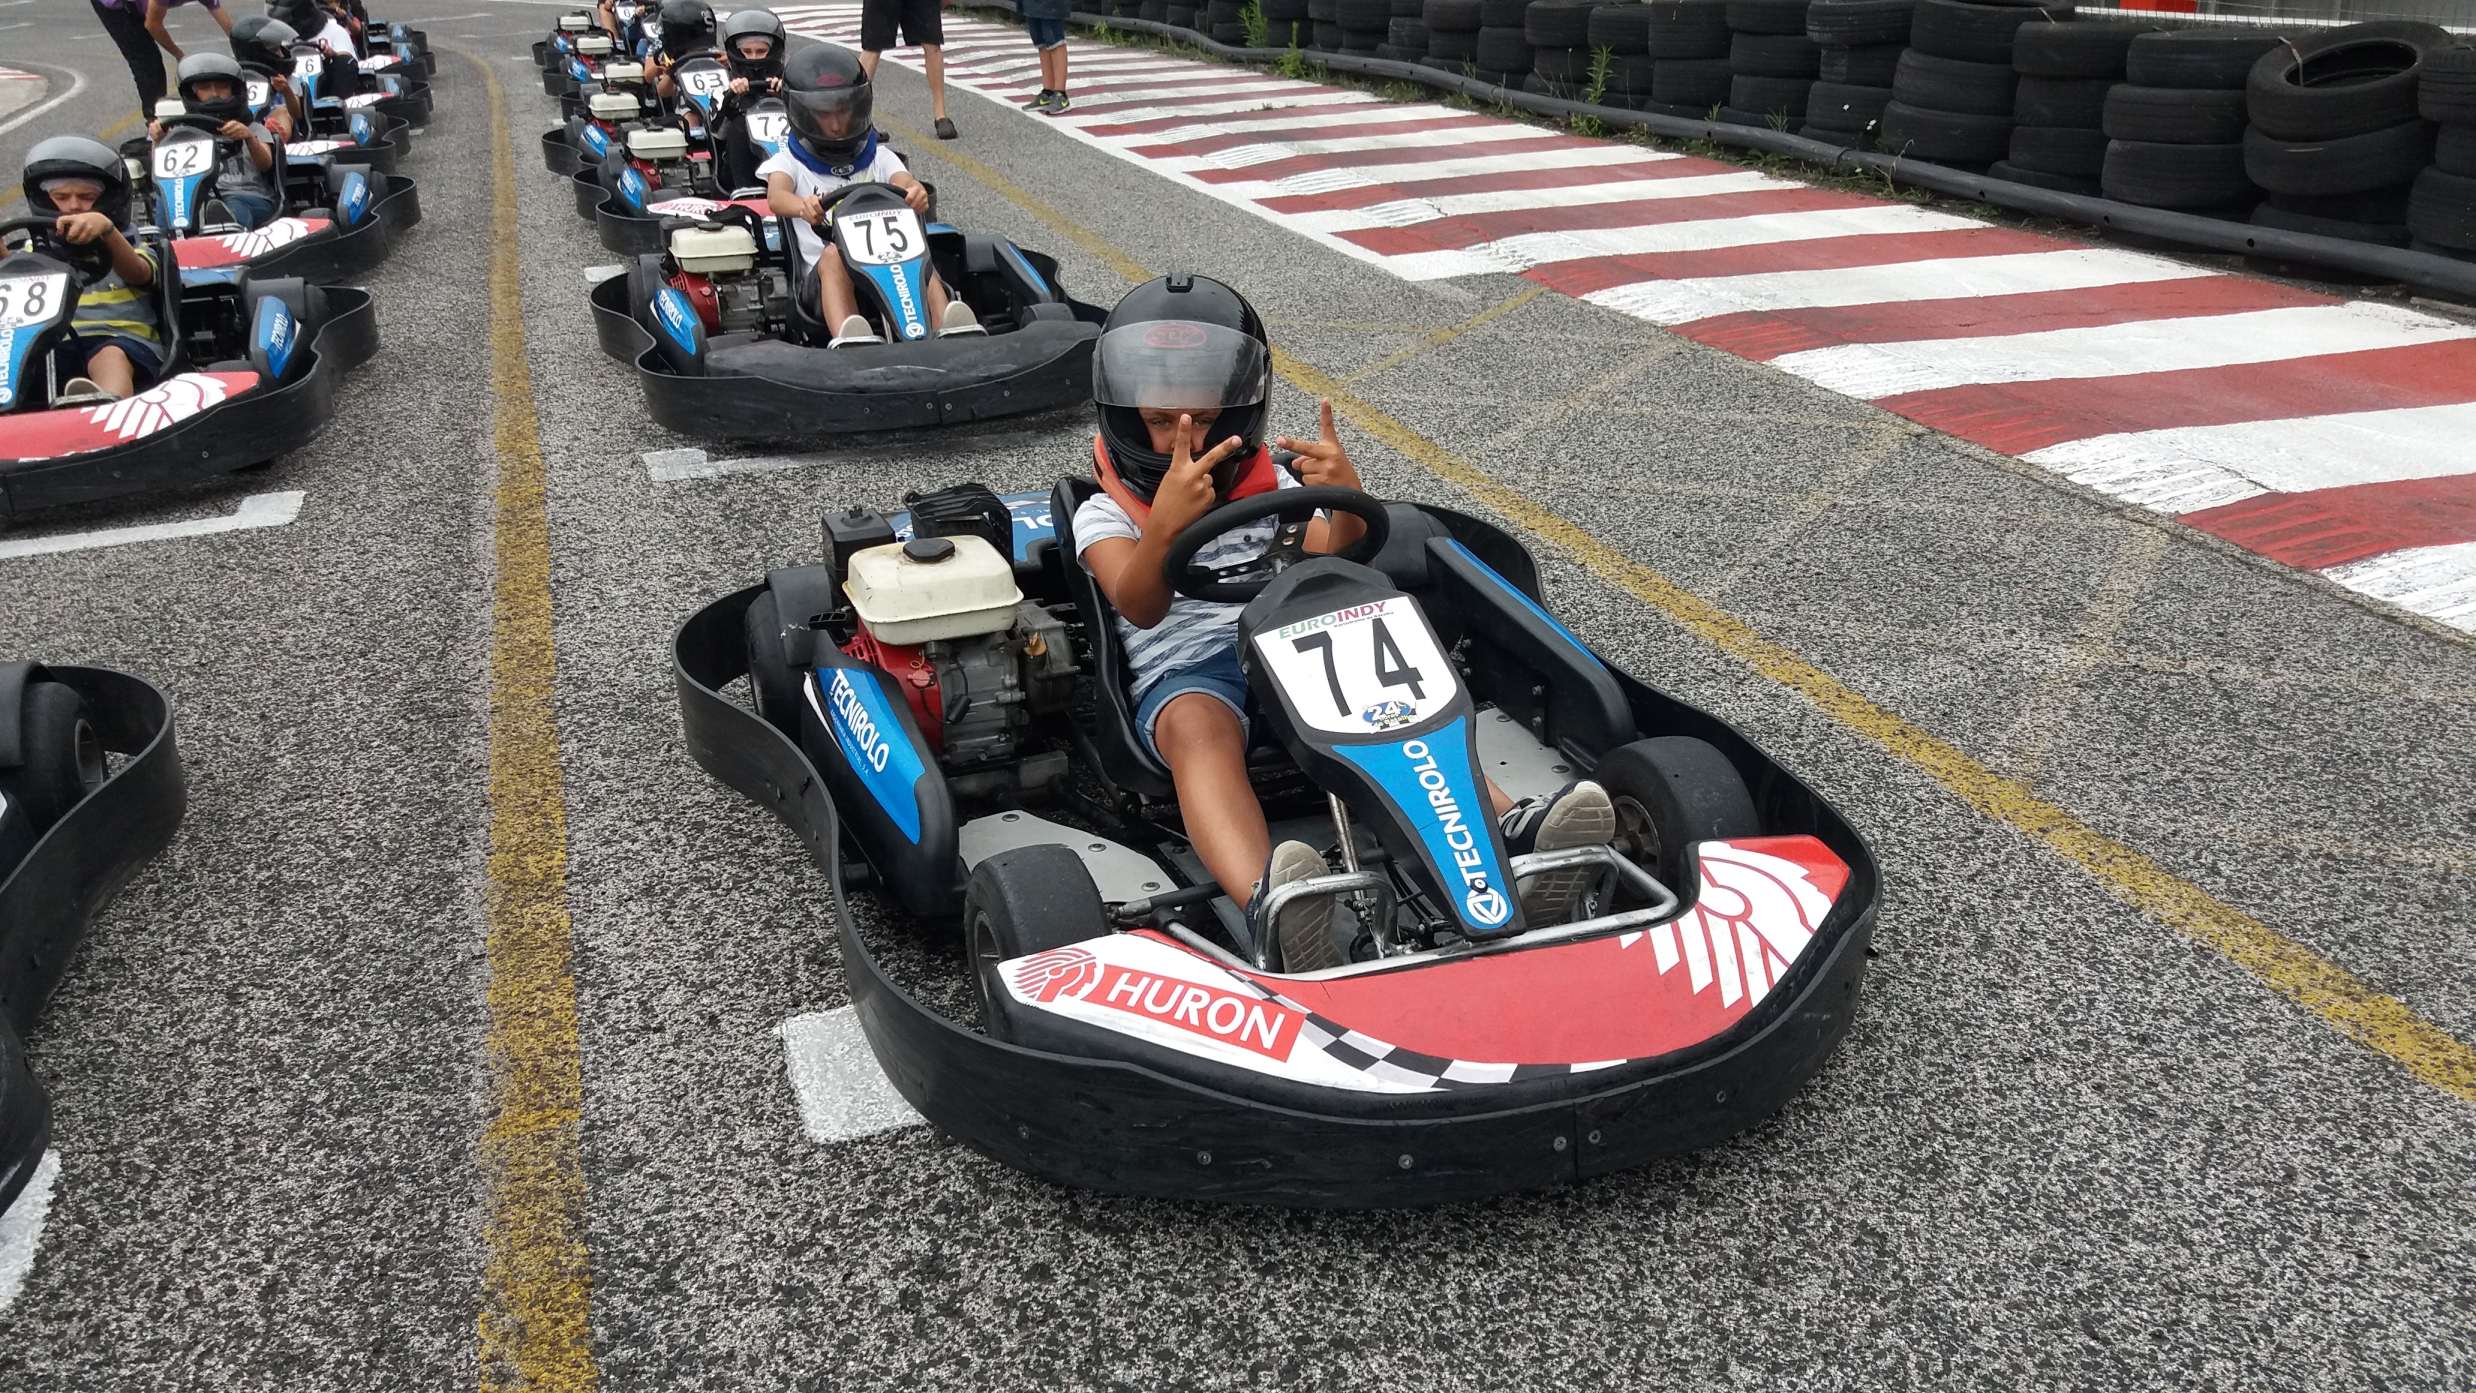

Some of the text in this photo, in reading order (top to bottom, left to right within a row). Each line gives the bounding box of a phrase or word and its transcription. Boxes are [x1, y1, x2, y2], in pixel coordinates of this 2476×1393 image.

[164, 144, 198, 172] 62
[853, 216, 908, 257] 75
[889, 264, 918, 323] TECNIROLO
[1279, 601, 1386, 640] EUROINDY
[1291, 617, 1426, 718] 74
[831, 668, 890, 773] TECNIROLO
[1402, 740, 1483, 888] TECNIROLO
[1108, 971, 1286, 1051] HURON
